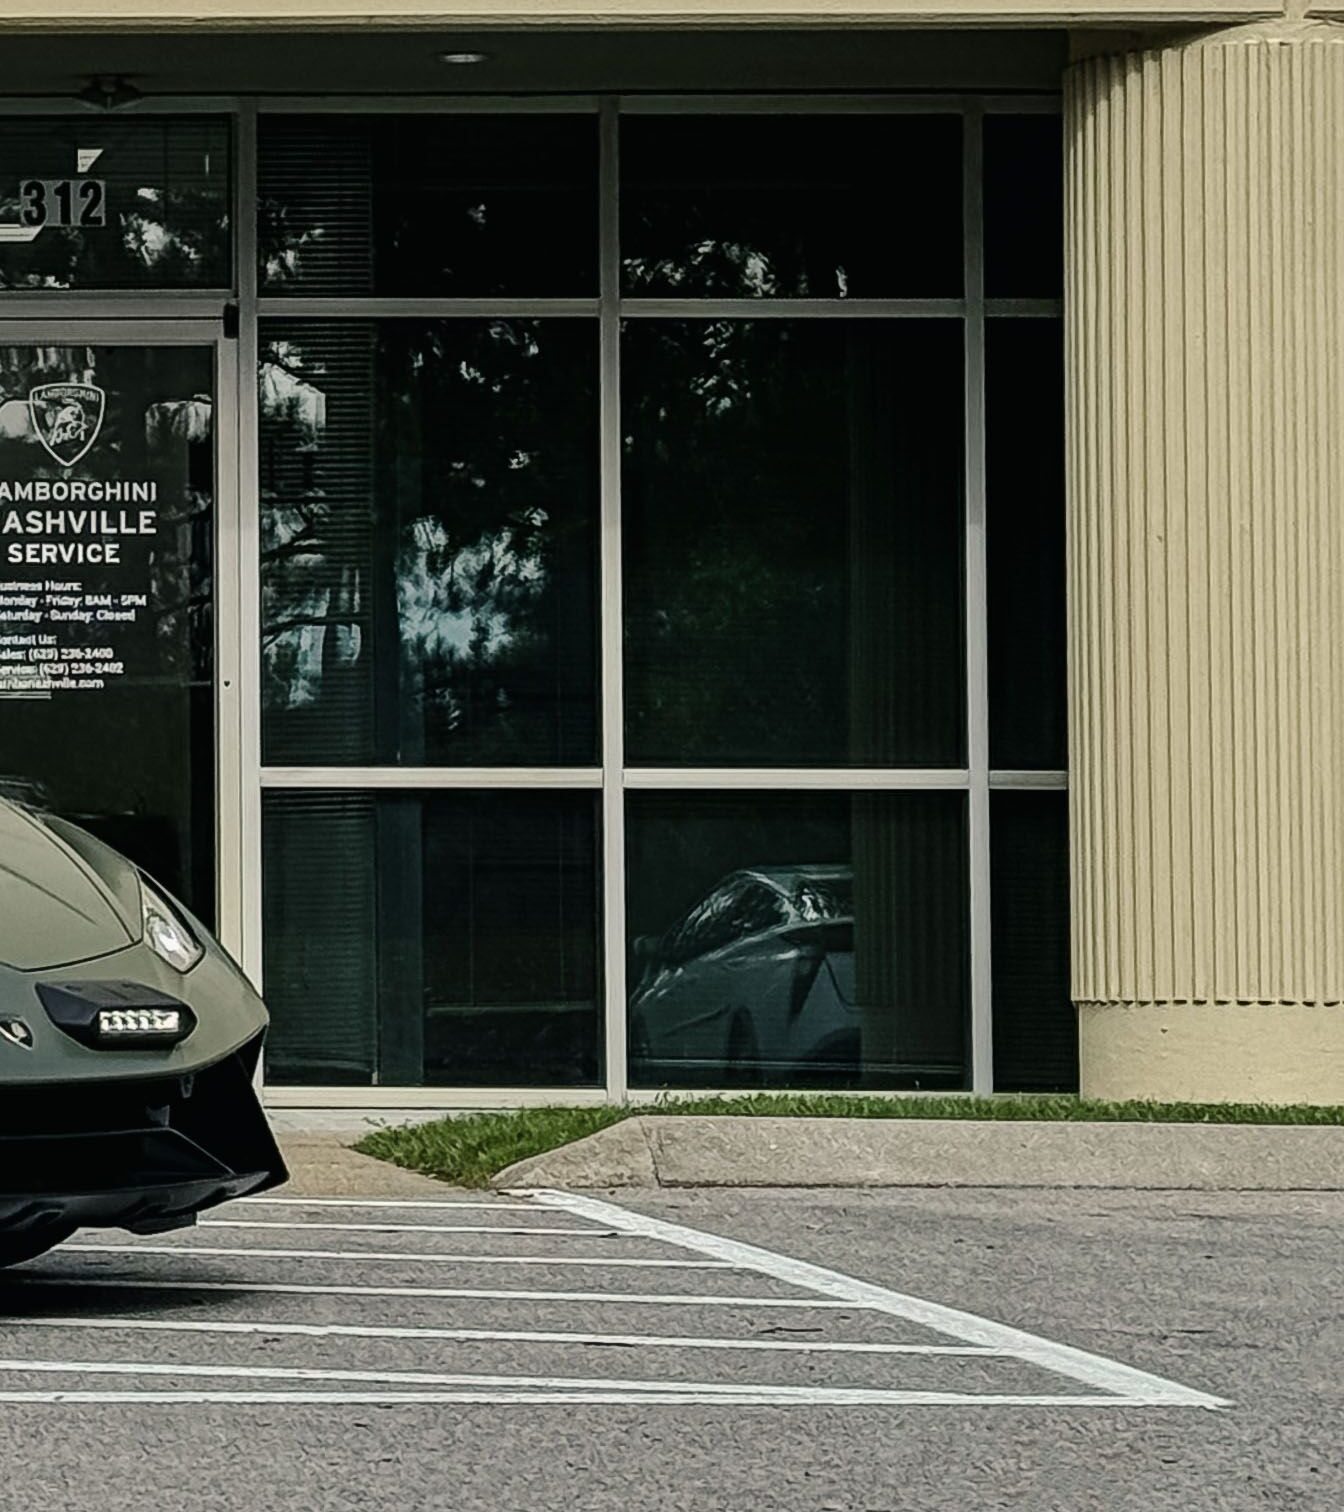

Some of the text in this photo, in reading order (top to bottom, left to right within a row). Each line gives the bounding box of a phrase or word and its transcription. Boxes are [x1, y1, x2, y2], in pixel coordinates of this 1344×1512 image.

[22, 180, 104, 226] 312
[7, 543, 121, 564] SERVICE
[120, 594, 147, 606] 5PM
[96, 609, 135, 621] Closed
